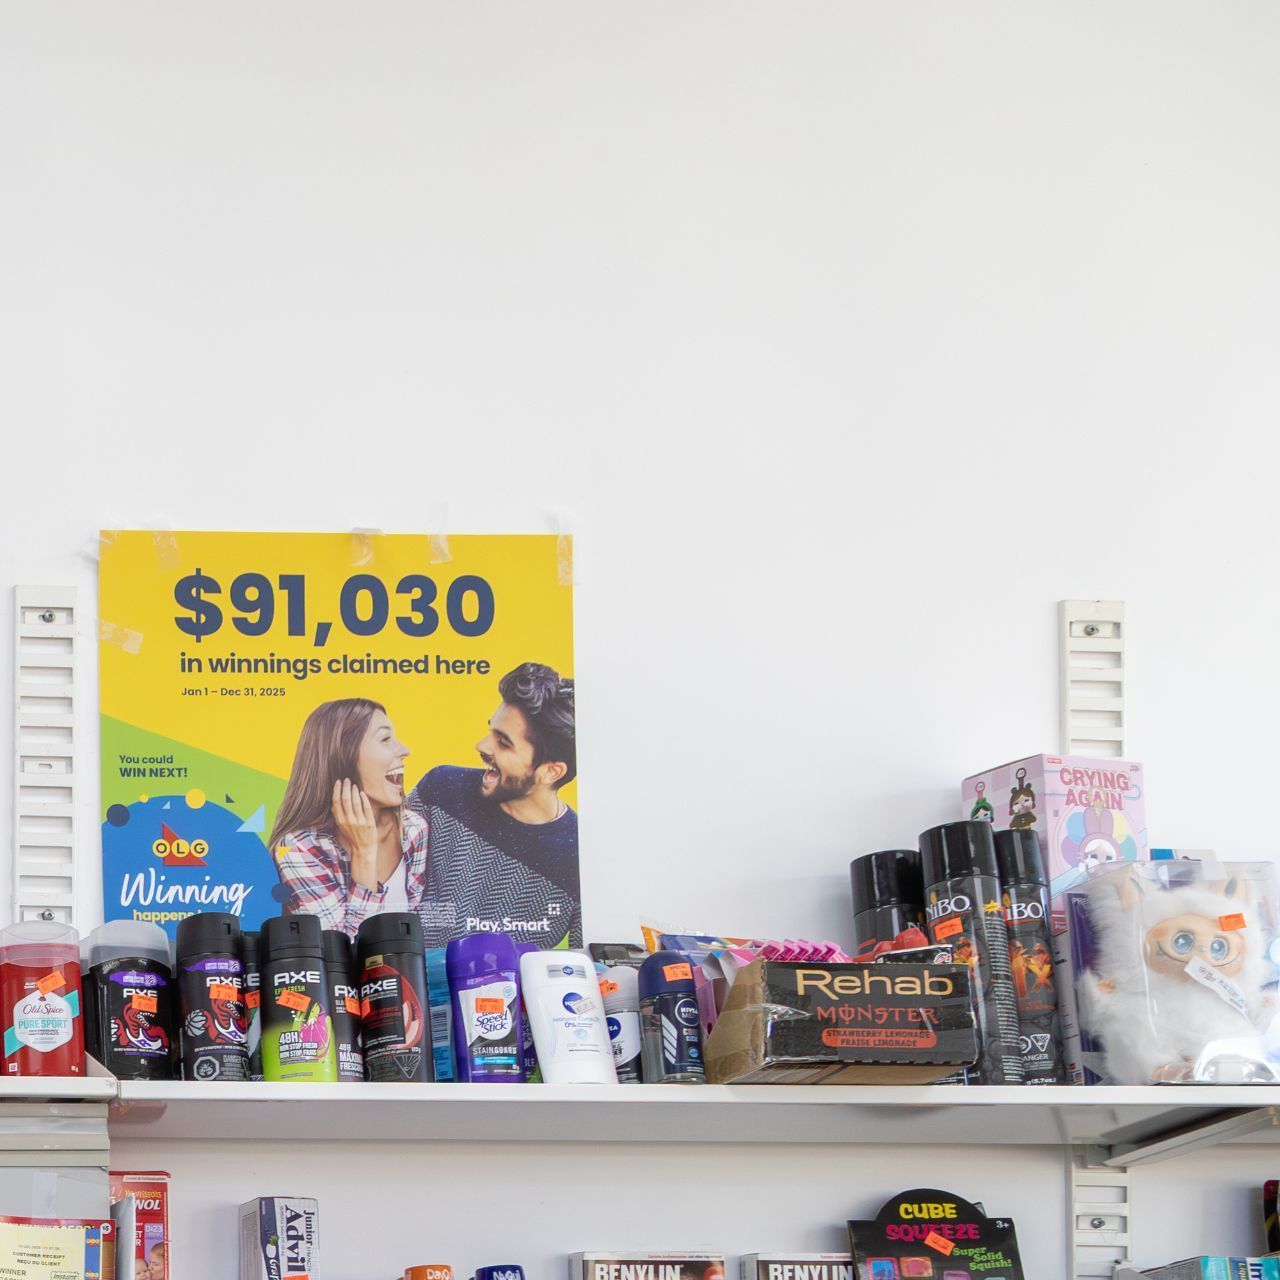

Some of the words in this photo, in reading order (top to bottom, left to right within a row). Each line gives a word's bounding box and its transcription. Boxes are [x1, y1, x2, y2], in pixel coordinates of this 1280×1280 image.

[173, 568, 495, 646] $91,030
[180, 652, 202, 673] in
[209, 654, 321, 679] winnings
[327, 655, 428, 675] claimed
[436, 655, 490, 675] here
[181, 687, 200, 696] Jan
[204, 687, 208, 696] 1
[220, 687, 240, 697] Dec
[242, 687, 257, 698] 31,
[261, 687, 286, 696] 2025
[119, 755, 140, 764] You
[143, 755, 173, 764] could
[119, 768, 146, 777] WIN
[149, 768, 187, 778] NEXT!
[1059, 766, 1129, 791] CRYING
[1065, 786, 1125, 810] AGAIN
[152, 839, 208, 857] OLG
[121, 867, 253, 917] Winning
[273, 971, 321, 986] AXE
[796, 969, 954, 1000] Rehab
[23, 1004, 40, 1015] Old
[41, 1004, 64, 1015] Spice
[19, 1019, 39, 1029] PURE
[41, 1019, 67, 1028] SPORT
[475, 1011, 508, 1028] Speed
[483, 1022, 508, 1034] Stick
[826, 1029, 879, 1039] STRAWBERRY
[881, 1029, 933, 1041] LEMONADE
[841, 1038, 871, 1047] FRAISE
[873, 1038, 919, 1049] LIMONADE
[473, 1047, 517, 1055] STAINGUARD
[899, 1203, 958, 1219] CUBE
[953, 1247, 987, 1257] Super
[973, 1252, 1003, 1261] Solid
[969, 1259, 1012, 1271] Squish!
